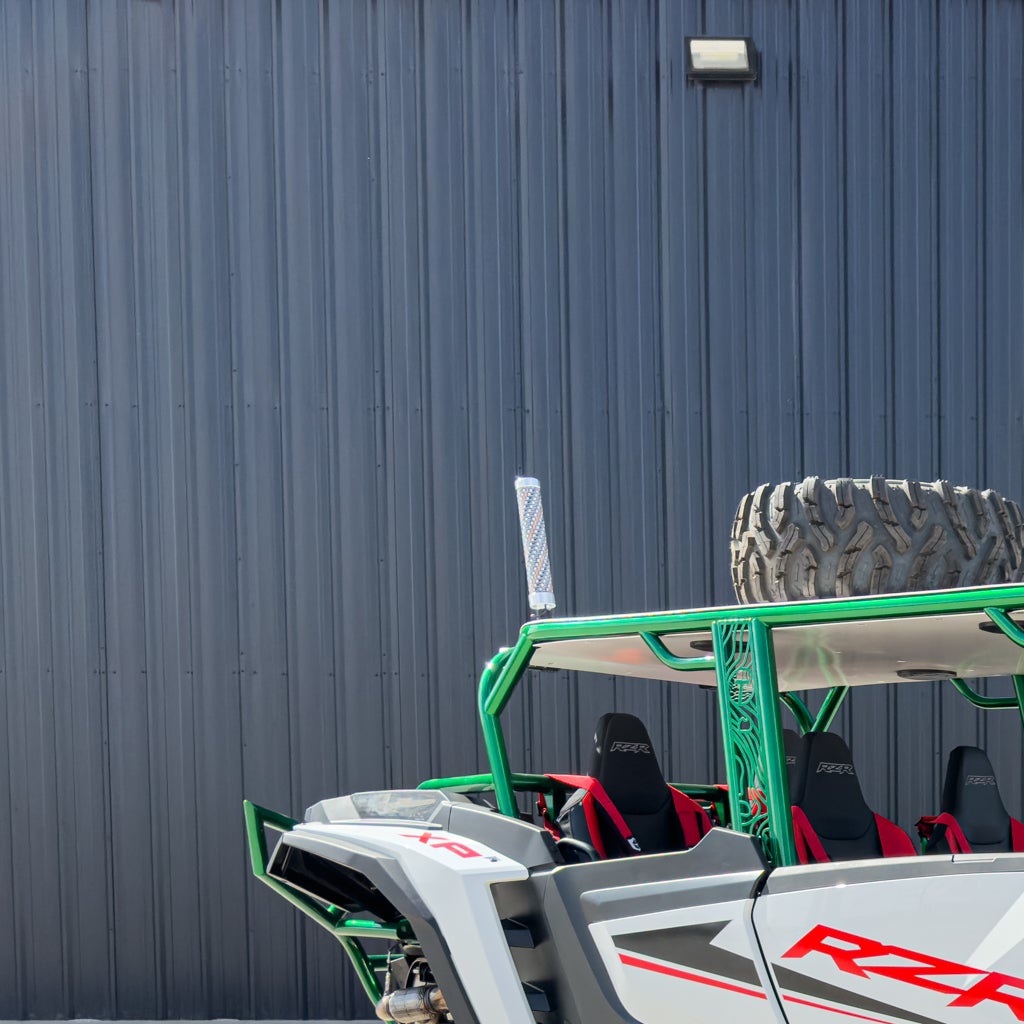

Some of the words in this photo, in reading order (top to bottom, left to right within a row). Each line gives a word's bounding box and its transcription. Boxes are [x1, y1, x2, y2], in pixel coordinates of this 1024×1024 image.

[610, 741, 650, 754] RZR
[816, 761, 855, 775] RZR
[398, 832, 483, 859] XP
